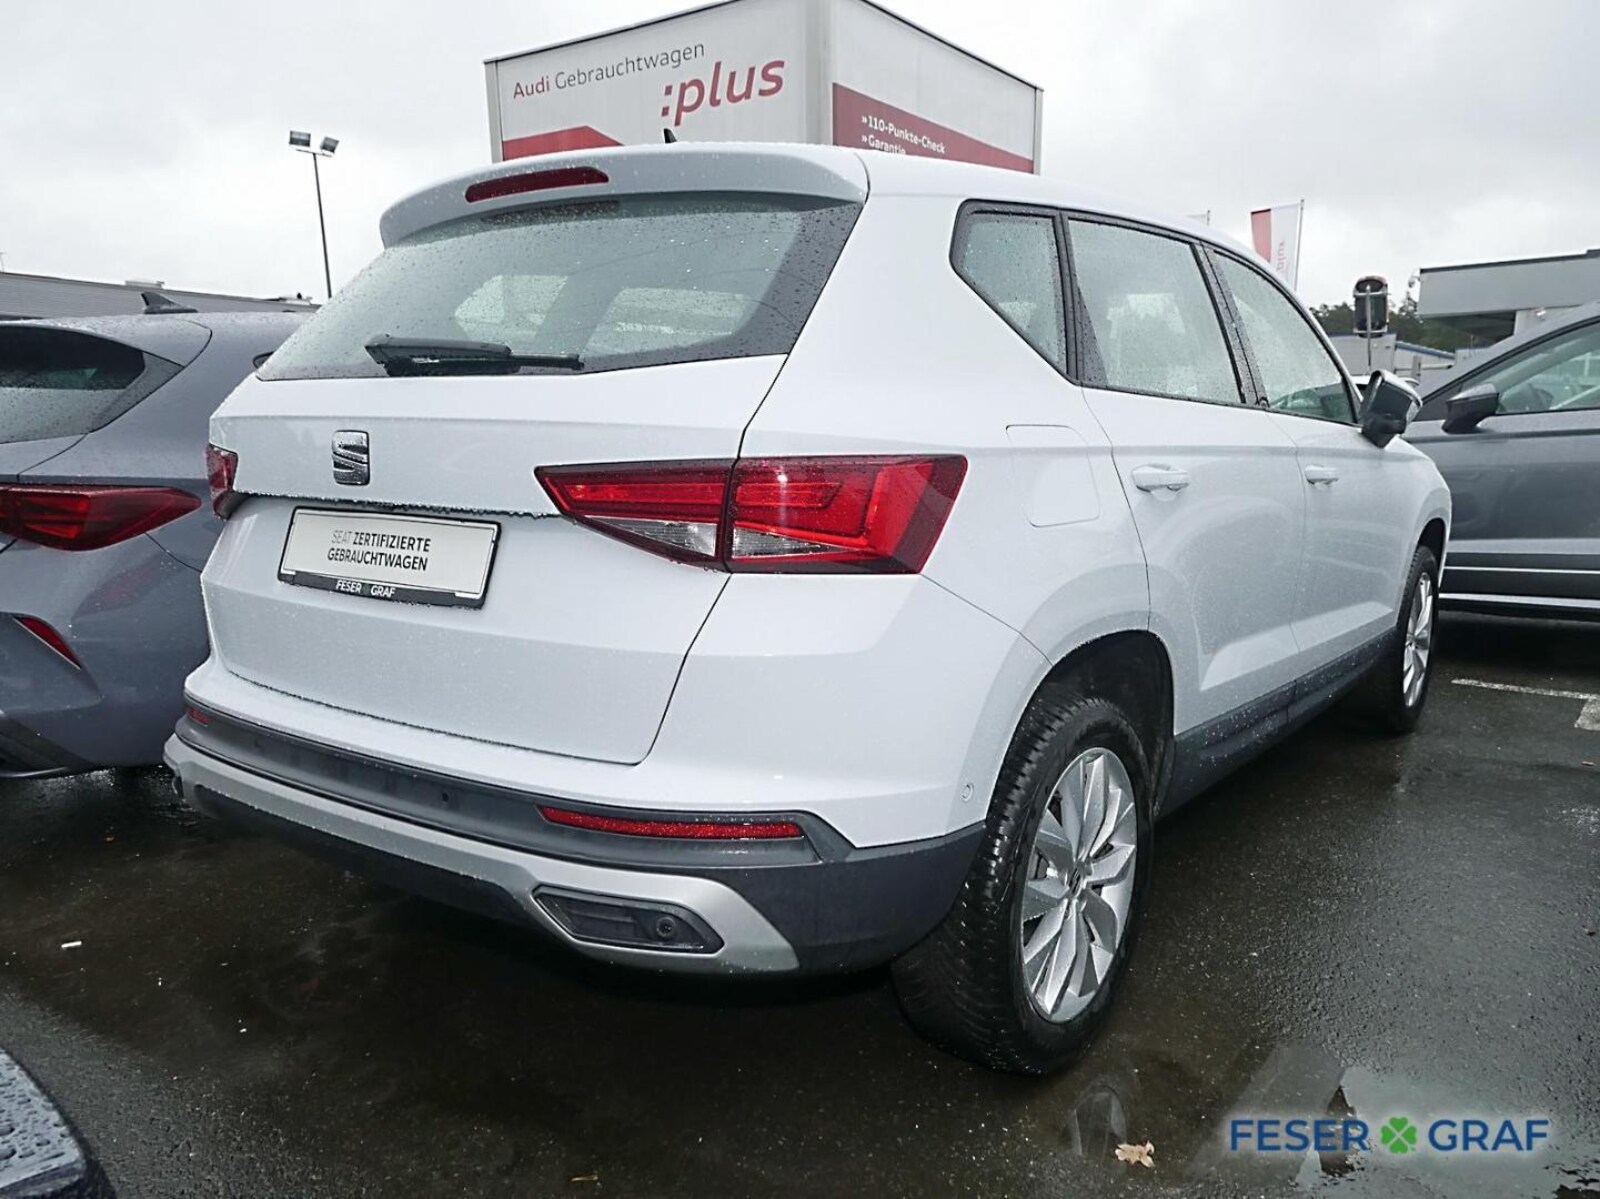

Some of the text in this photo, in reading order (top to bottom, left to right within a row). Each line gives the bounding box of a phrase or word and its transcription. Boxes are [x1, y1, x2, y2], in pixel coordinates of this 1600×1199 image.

[513, 43, 706, 99] Audi Gebrauchtwagen
[332, 529, 432, 553] SEAT ZERTIFIZIERTE
[327, 547, 429, 572] GEBRAUCHTWAGEN
[335, 579, 396, 598] FESER GRAF
